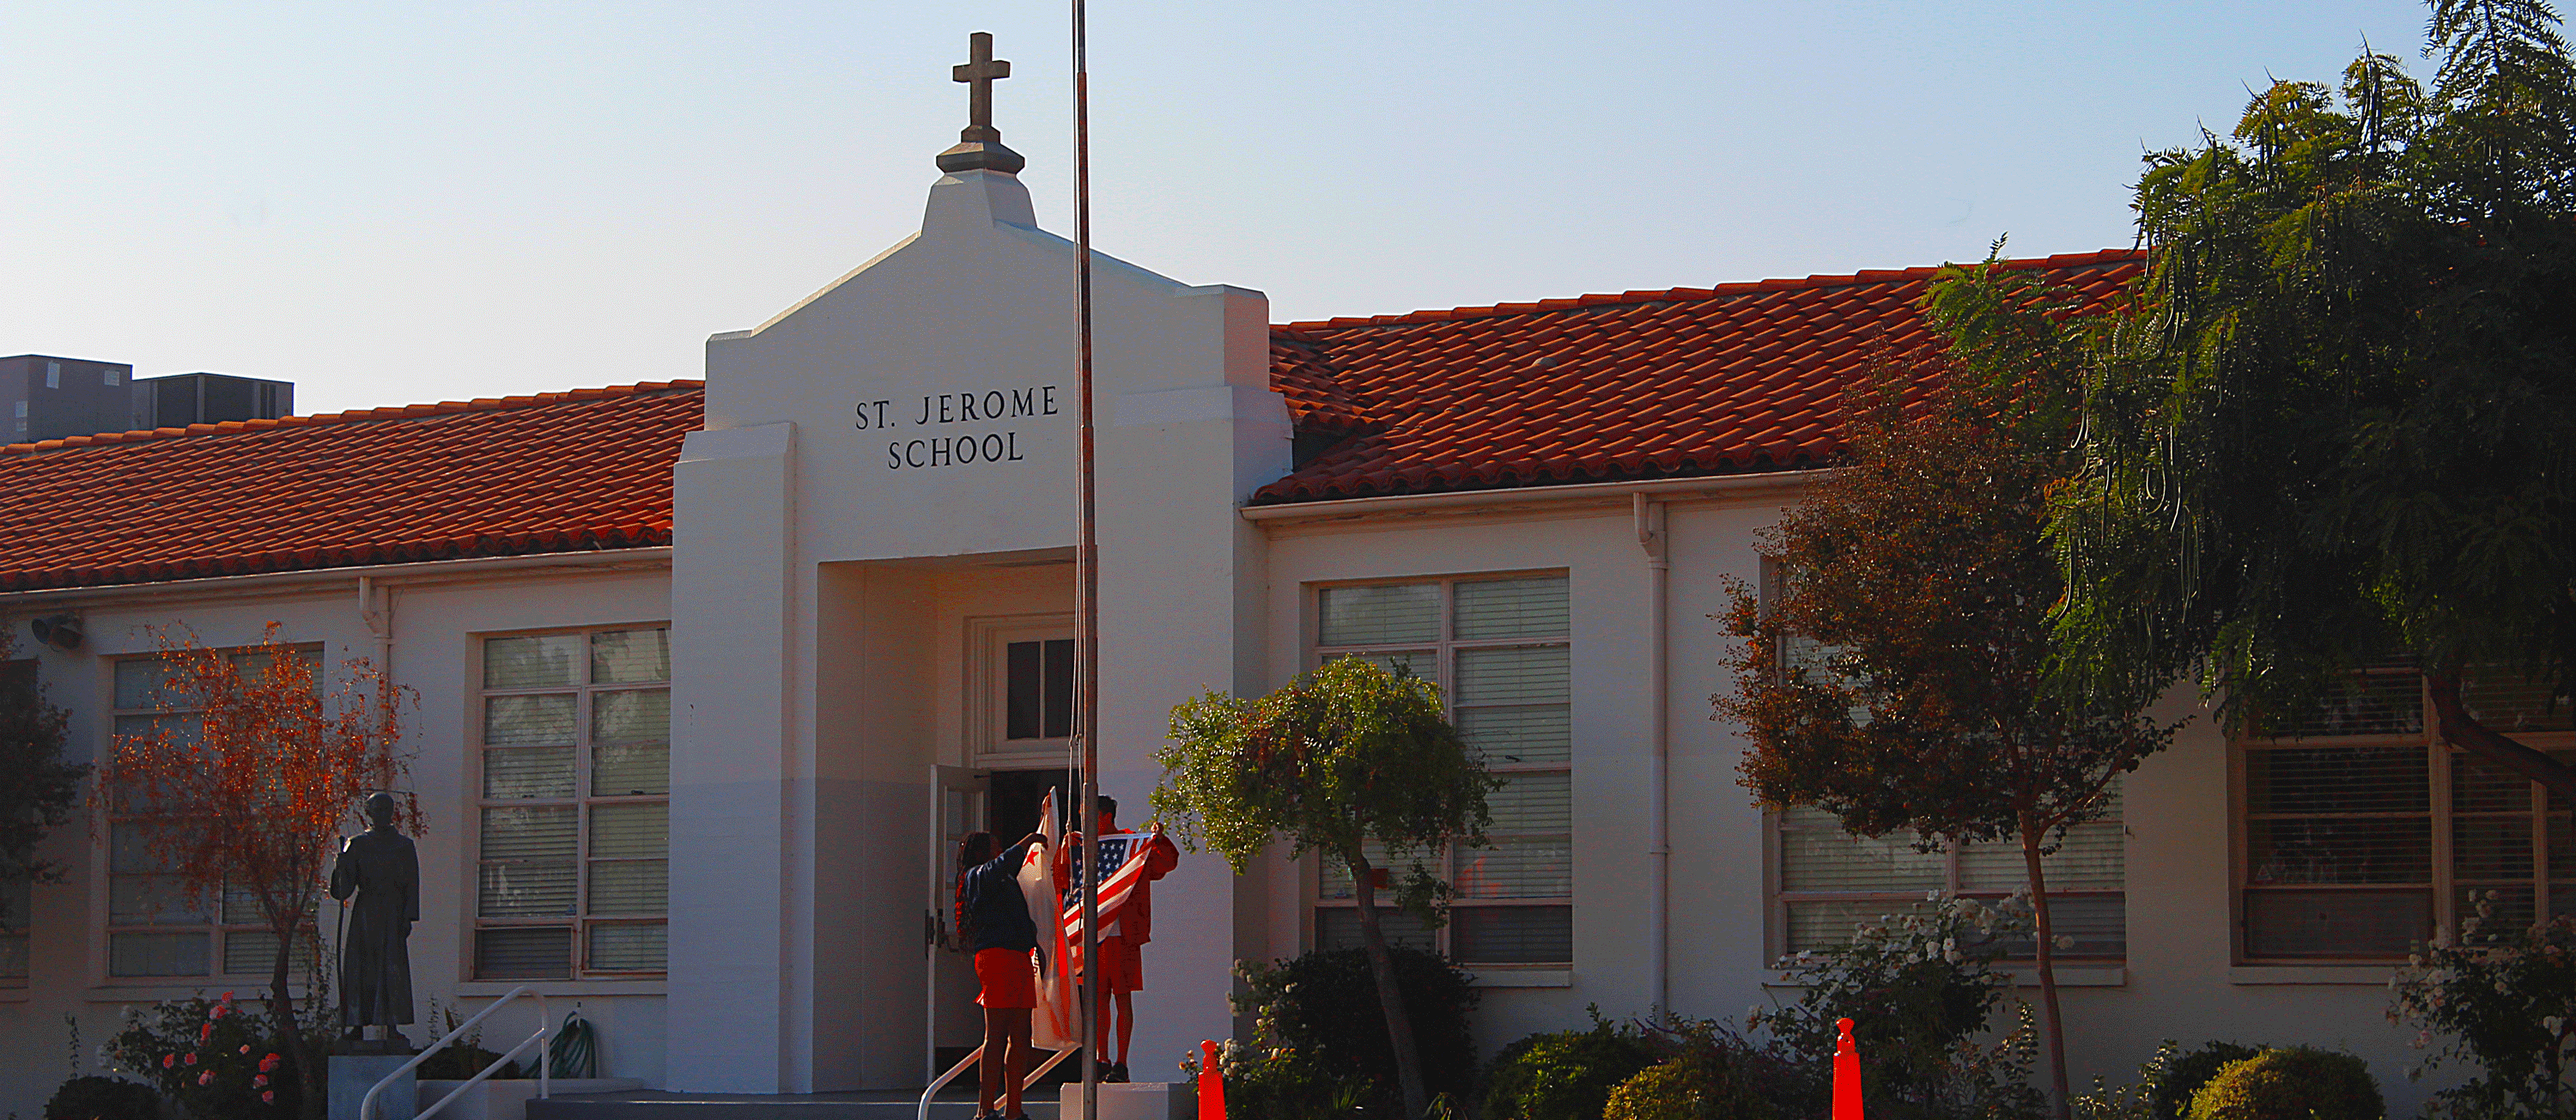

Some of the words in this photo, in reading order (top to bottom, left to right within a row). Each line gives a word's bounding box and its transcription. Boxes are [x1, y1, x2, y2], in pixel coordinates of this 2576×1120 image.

[855, 400, 896, 430] ST.
[915, 386, 1059, 425] JEROME
[888, 432, 1024, 470] SCHOOL
